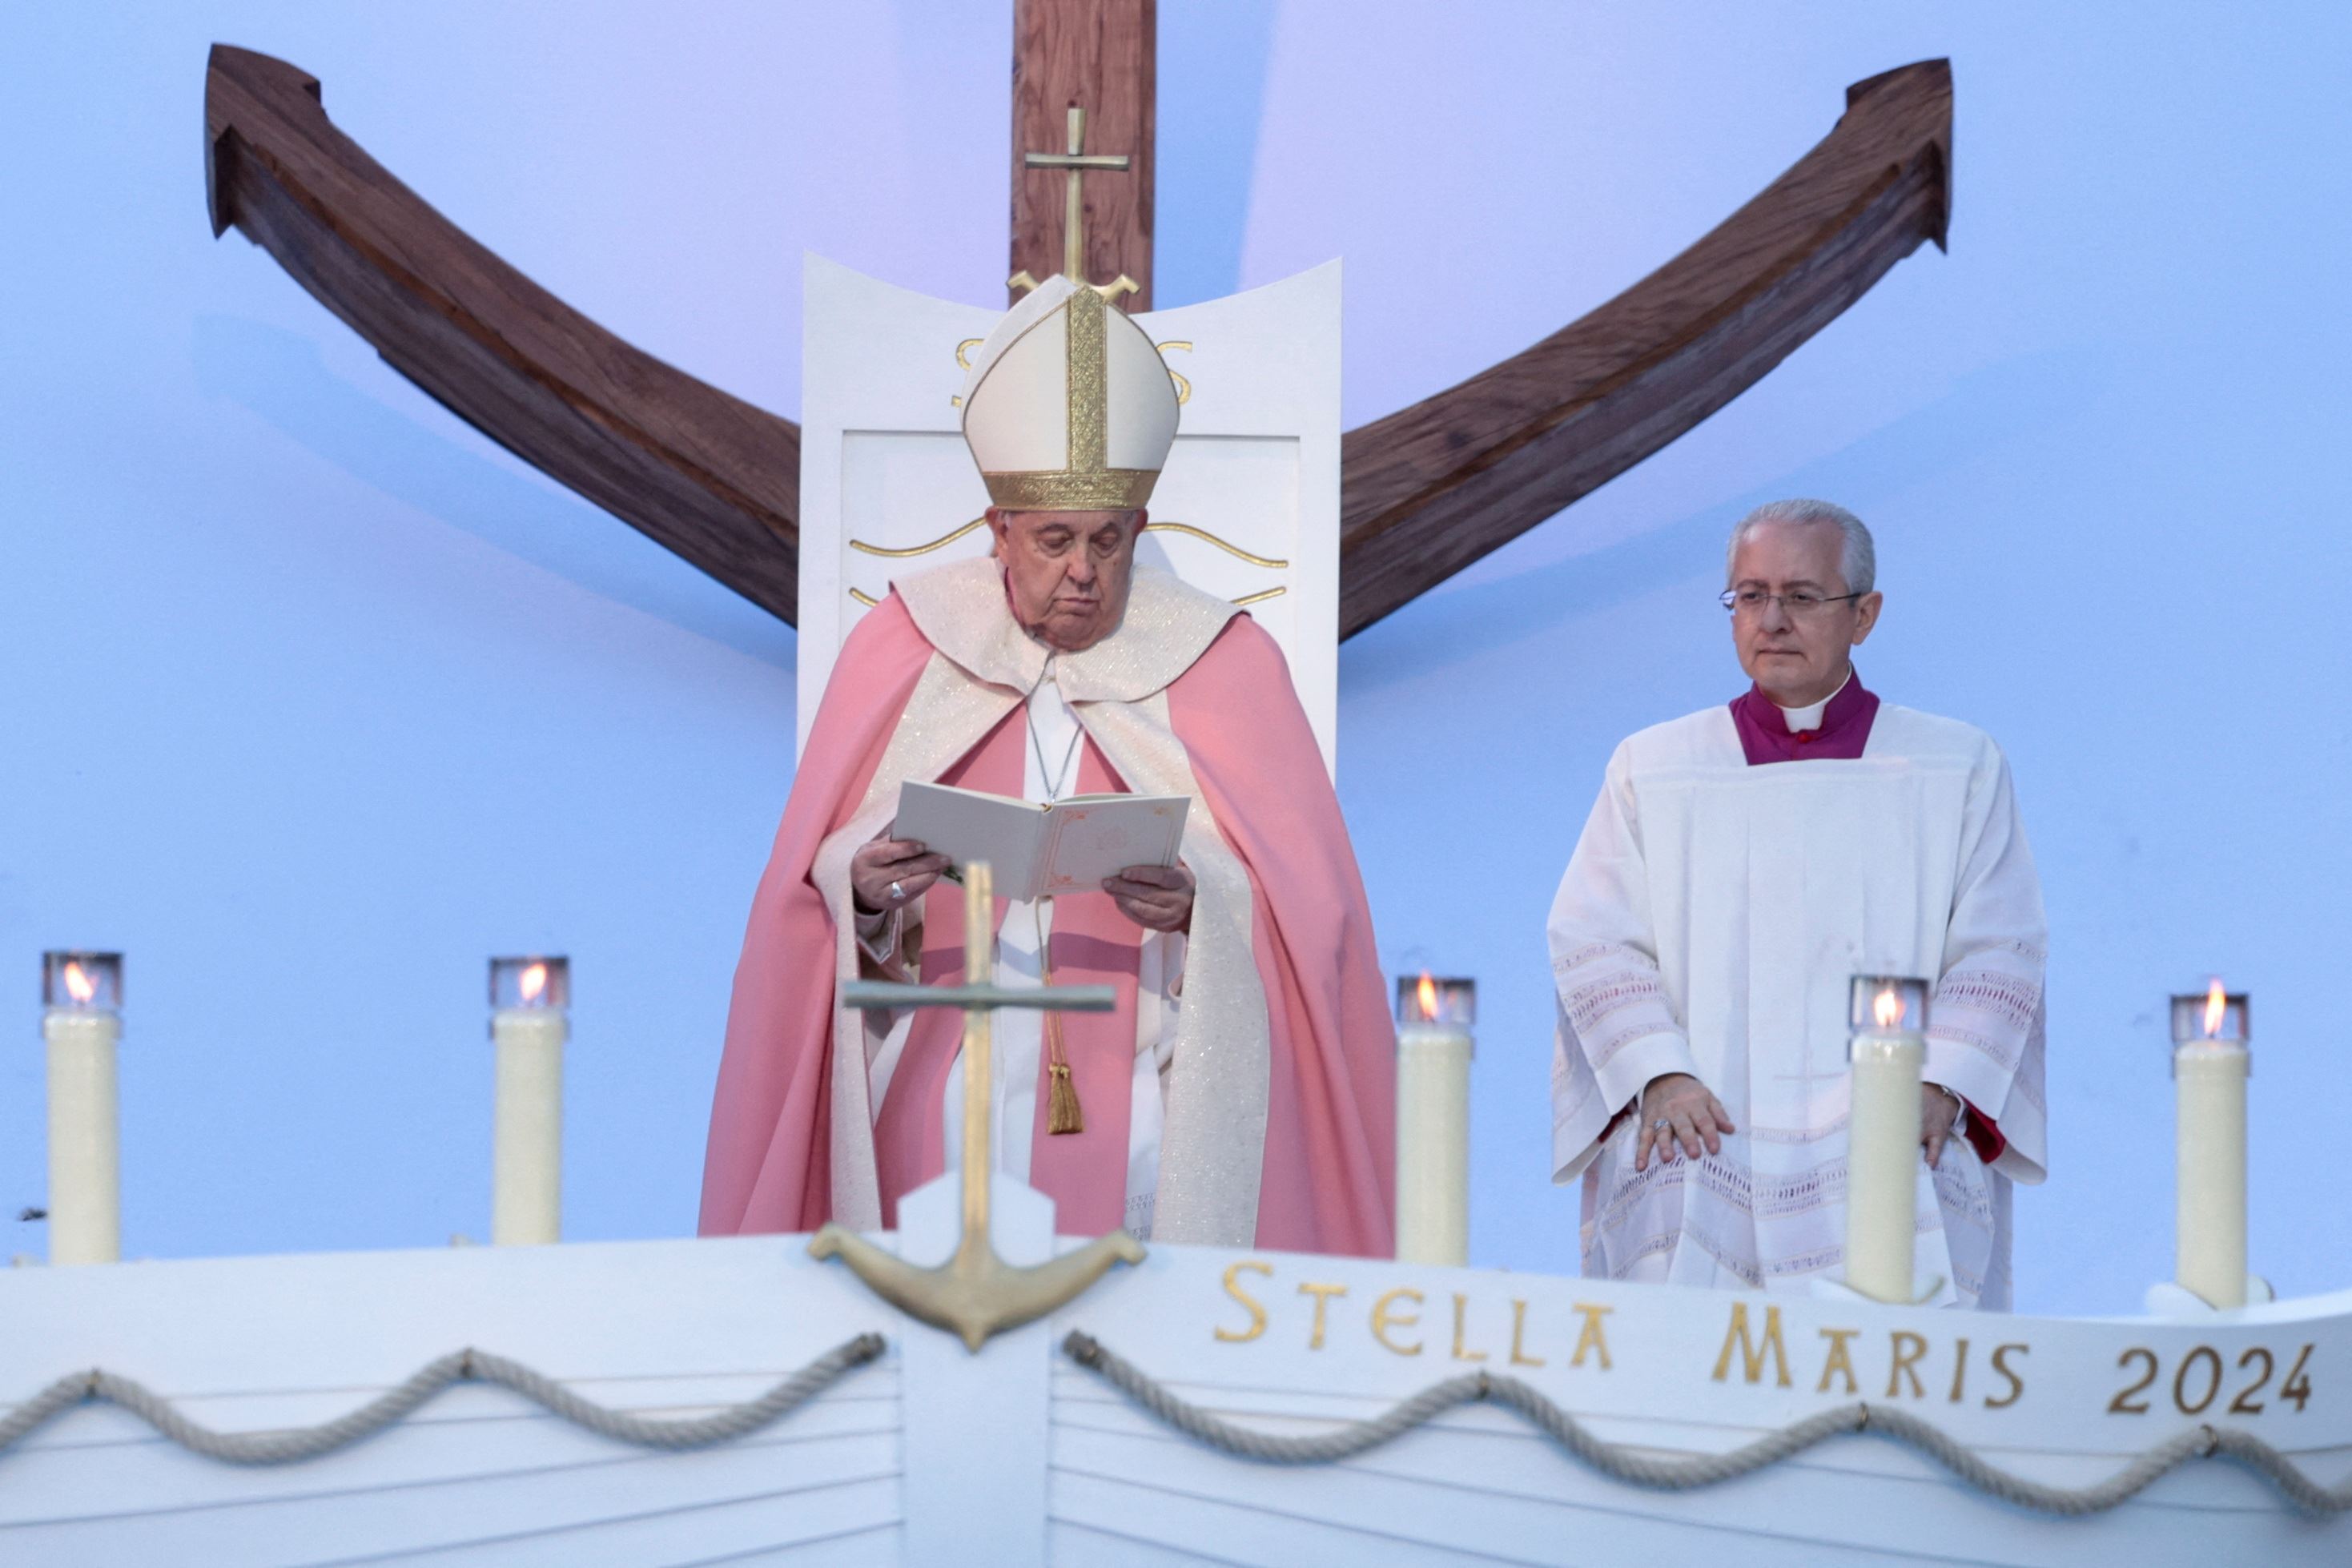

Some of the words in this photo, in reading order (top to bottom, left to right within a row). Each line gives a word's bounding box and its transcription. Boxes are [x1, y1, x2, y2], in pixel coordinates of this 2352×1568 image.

[1214, 1260, 1614, 1369] STELLA
[1711, 1301, 2029, 1408] MARIS
[2107, 1344, 2315, 1415] 2024
